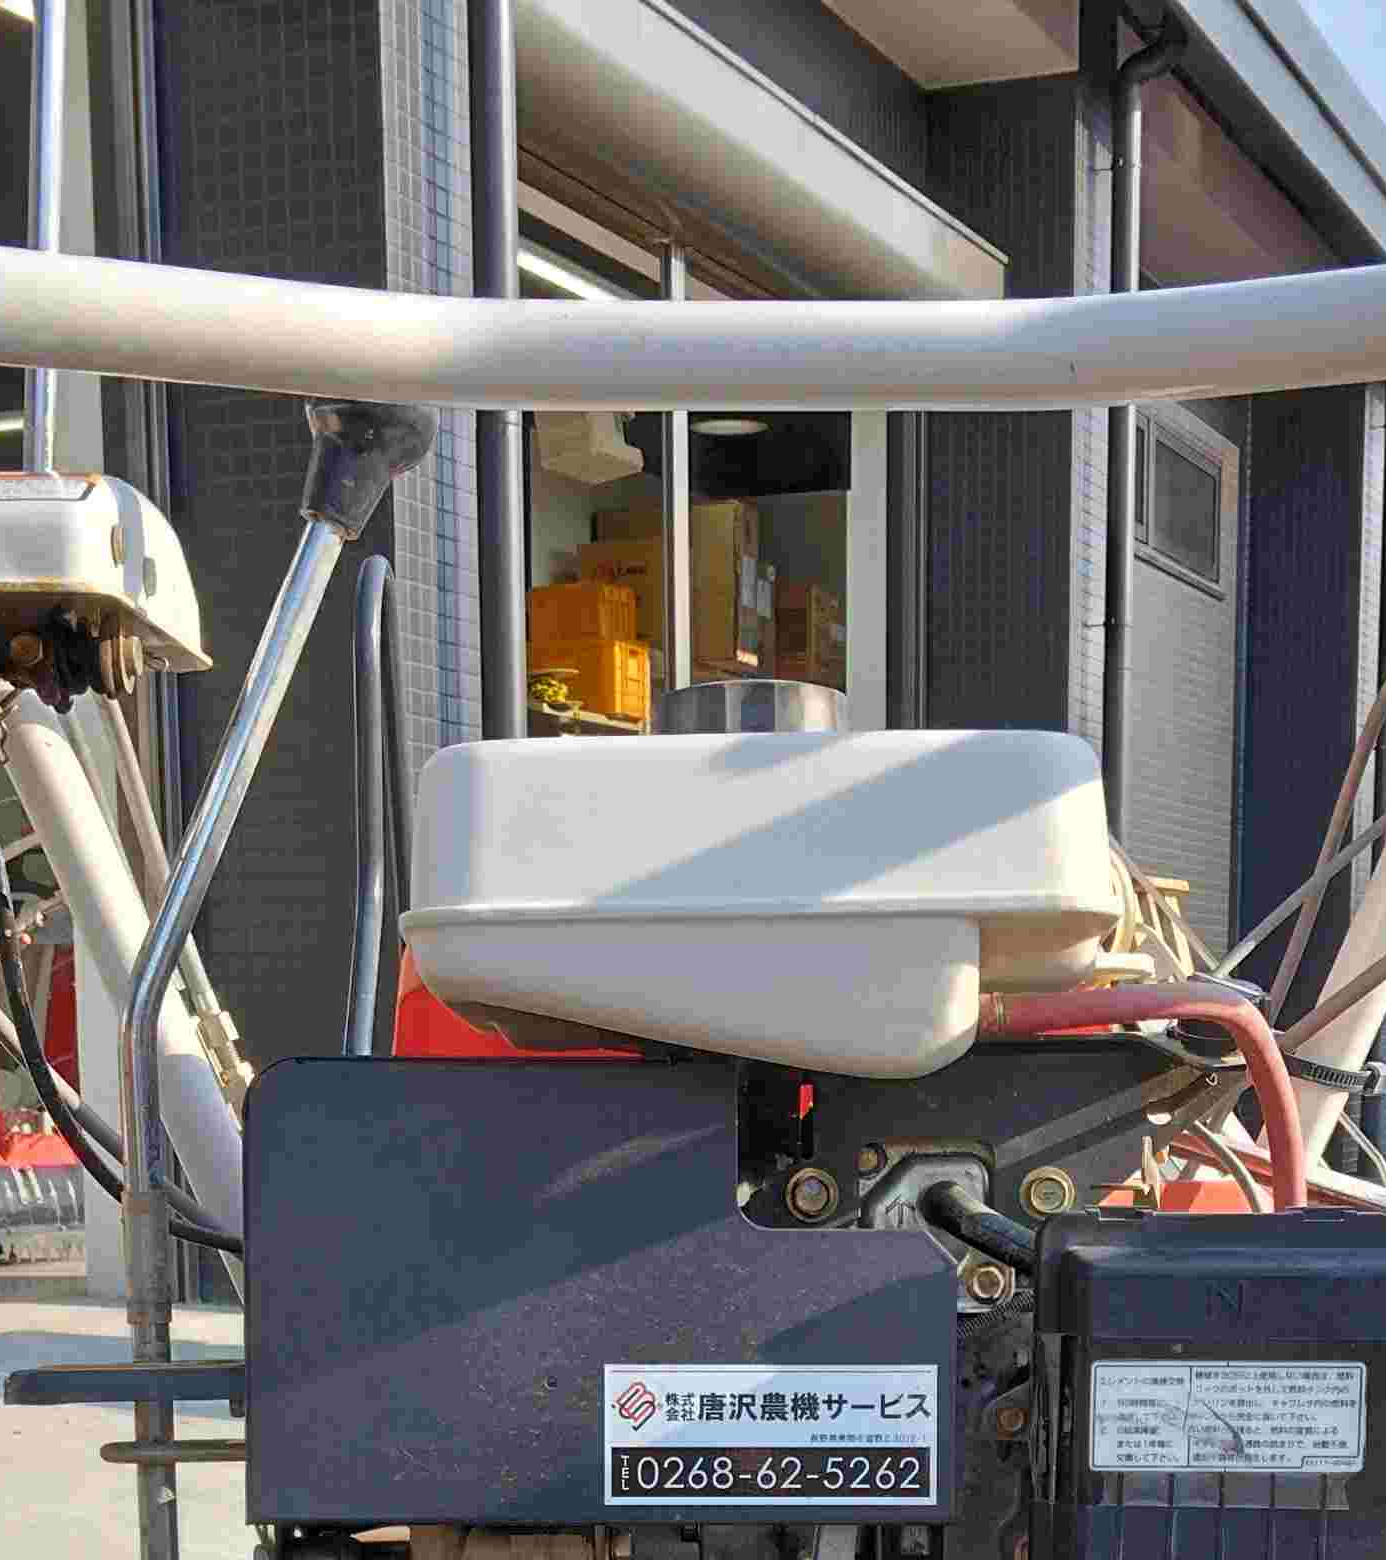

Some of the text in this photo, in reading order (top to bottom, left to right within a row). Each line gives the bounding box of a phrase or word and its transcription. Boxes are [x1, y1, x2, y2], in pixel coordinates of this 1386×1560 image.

[665, 1393, 695, 1406] 株式
[697, 1392, 932, 1422] 唐沢農機サービス
[665, 1407, 695, 1421] 会社
[620, 1455, 921, 1490] TEL 0268-62-5262
